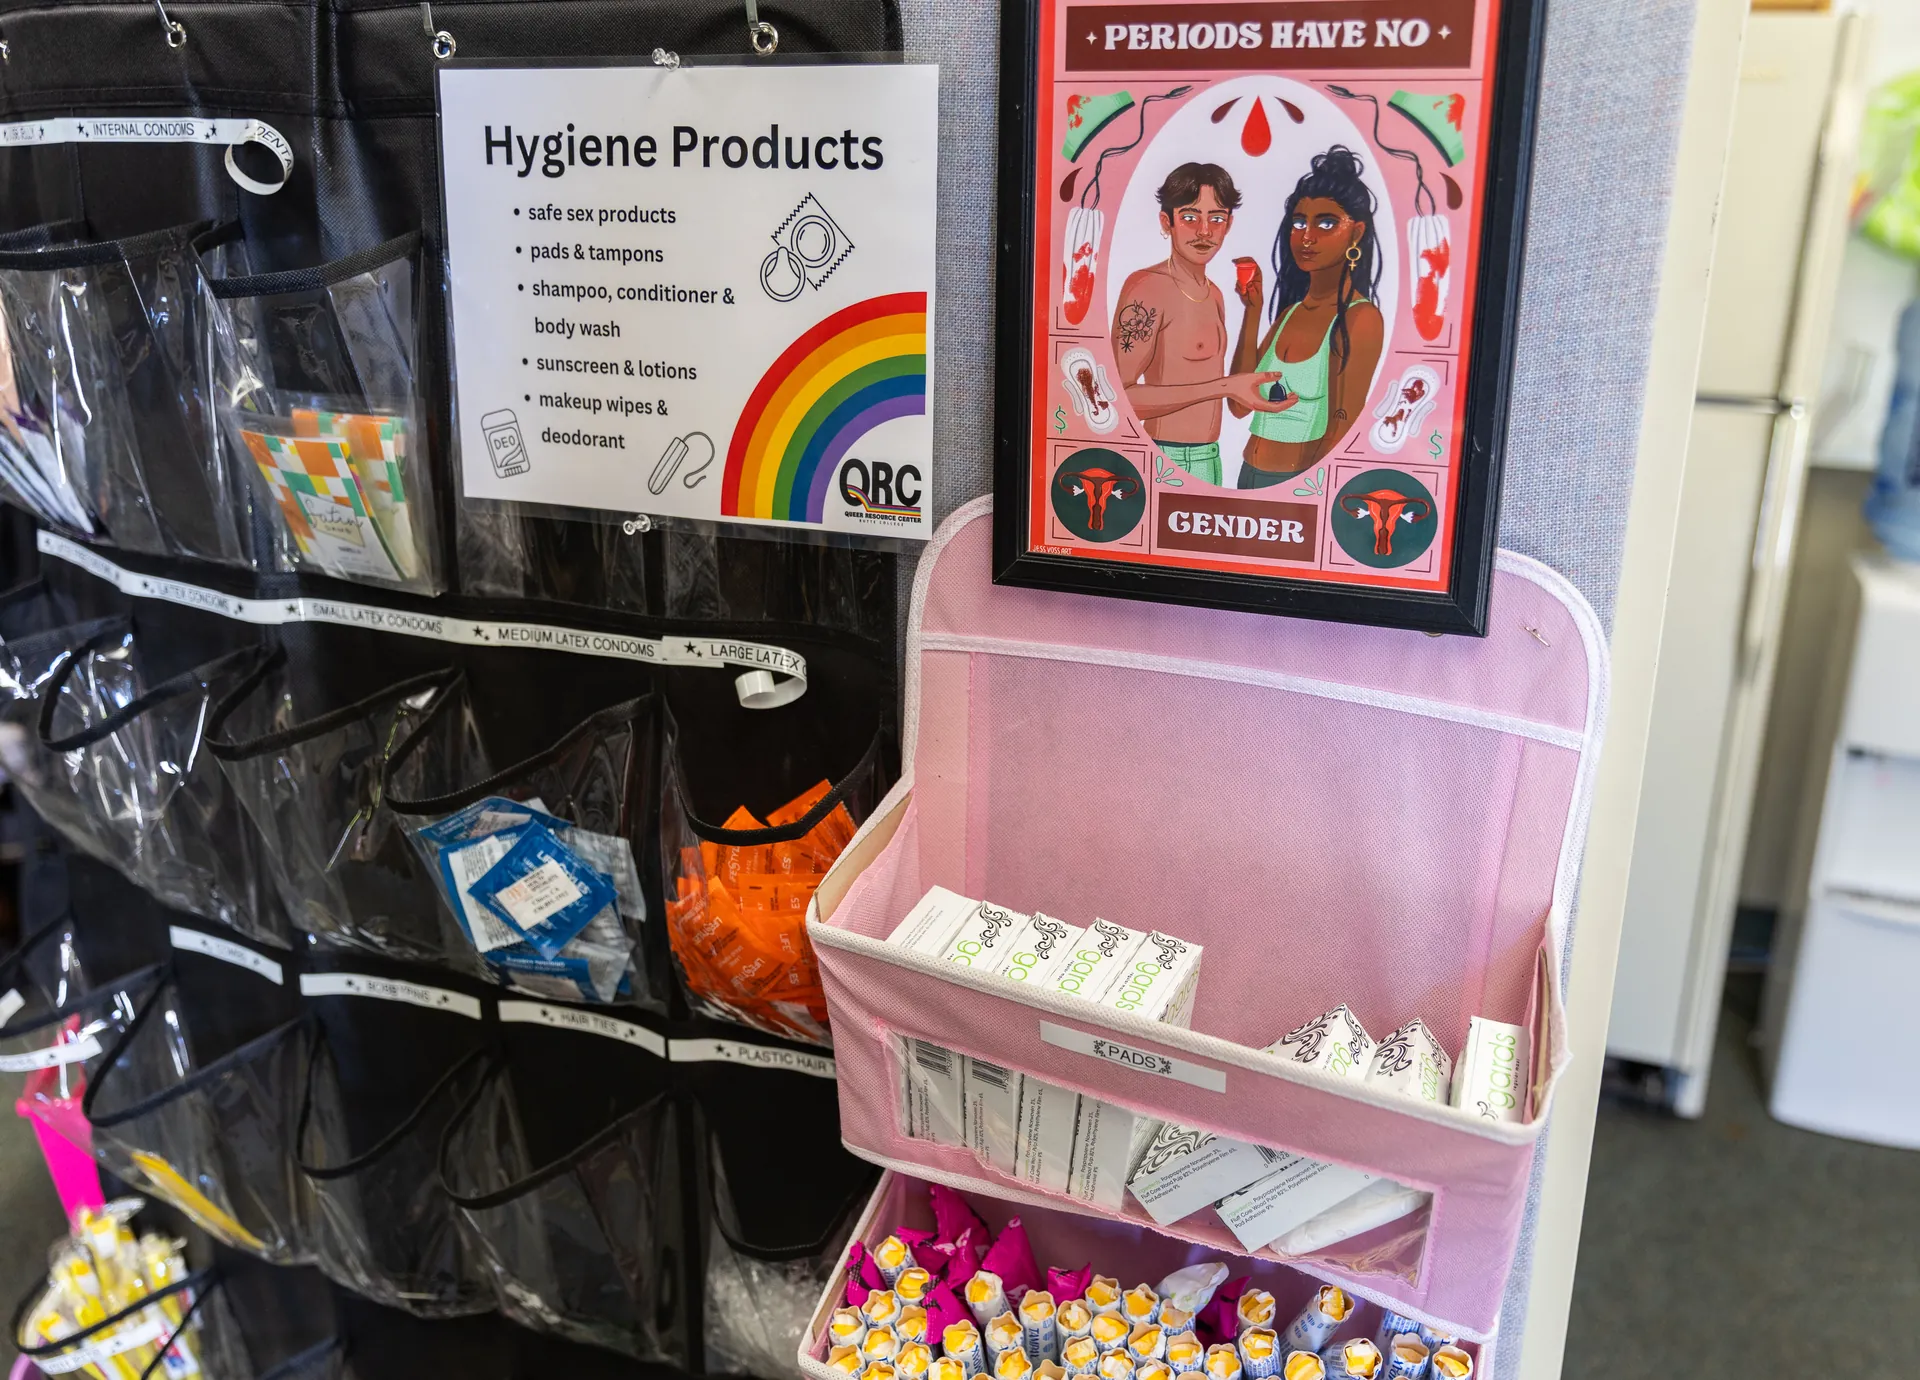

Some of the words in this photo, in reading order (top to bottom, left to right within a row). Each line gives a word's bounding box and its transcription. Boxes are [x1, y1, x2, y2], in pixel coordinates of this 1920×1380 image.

[1104, 22, 1263, 50] PERIODS
[1270, 20, 1367, 49] HAVE
[1375, 18, 1430, 48] NO
[93, 122, 142, 137] INTERNAL
[144, 122, 195, 137] CONDOMS
[484, 123, 658, 179] Hygiene
[673, 124, 885, 171] Products
[528, 204, 563, 223] safe
[566, 207, 594, 223] sex
[598, 205, 677, 227] products
[530, 242, 571, 262] pads
[573, 244, 586, 261] &
[588, 244, 664, 266] tampons
[532, 279, 612, 304] shampoo,
[616, 282, 718, 305] conditioner
[722, 287, 736, 306] &
[535, 316, 576, 340] body
[579, 318, 621, 338] wash
[536, 355, 620, 376] sunscreen
[623, 359, 636, 377] &
[638, 360, 697, 381] lotions
[539, 392, 603, 413] makeup
[606, 396, 654, 418] wipes
[656, 399, 669, 417] &
[493, 434, 516, 451] DEO
[541, 427, 626, 450] deodorant
[839, 458, 922, 508] QRC
[865, 512, 897, 521] RESOURCE
[898, 515, 922, 524] CENTER
[1168, 510, 1305, 544] GENDER
[1061, 548, 1073, 556] ART
[311, 603, 347, 620] SMALL
[350, 607, 383, 624] LATEX
[387, 613, 443, 634] CONDOMS
[498, 628, 553, 643] MEDIUM
[555, 632, 590, 649] LATEX
[593, 637, 655, 657] CONDOMS
[711, 644, 754, 661] LARGE
[756, 648, 800, 672] LATEX
[1056, 949, 1102, 996] gard
[1115, 961, 1161, 1011] gards
[560, 1012, 589, 1027] HAIR
[593, 1016, 618, 1035] TIES
[738, 1046, 793, 1066] PLASTIC
[797, 1056, 827, 1073] HAIR
[1108, 1044, 1157, 1070] PADS
[1487, 1032, 1516, 1109] gards
[1160, 1163, 1190, 1182] Polypropylene
[1189, 1151, 1213, 1166] Nonwoven
[1153, 1186, 1173, 1200] Adhesive
[1240, 1207, 1253, 1217] Core
[1252, 1199, 1266, 1210] Wood
[1265, 1193, 1277, 1203] Pulp
[1287, 1169, 1318, 1190] Polyethylene
[1252, 1181, 1286, 1203] Polypropylene
[1285, 1166, 1311, 1183] Nonwoven
[1244, 1207, 1266, 1222] Adhesive
